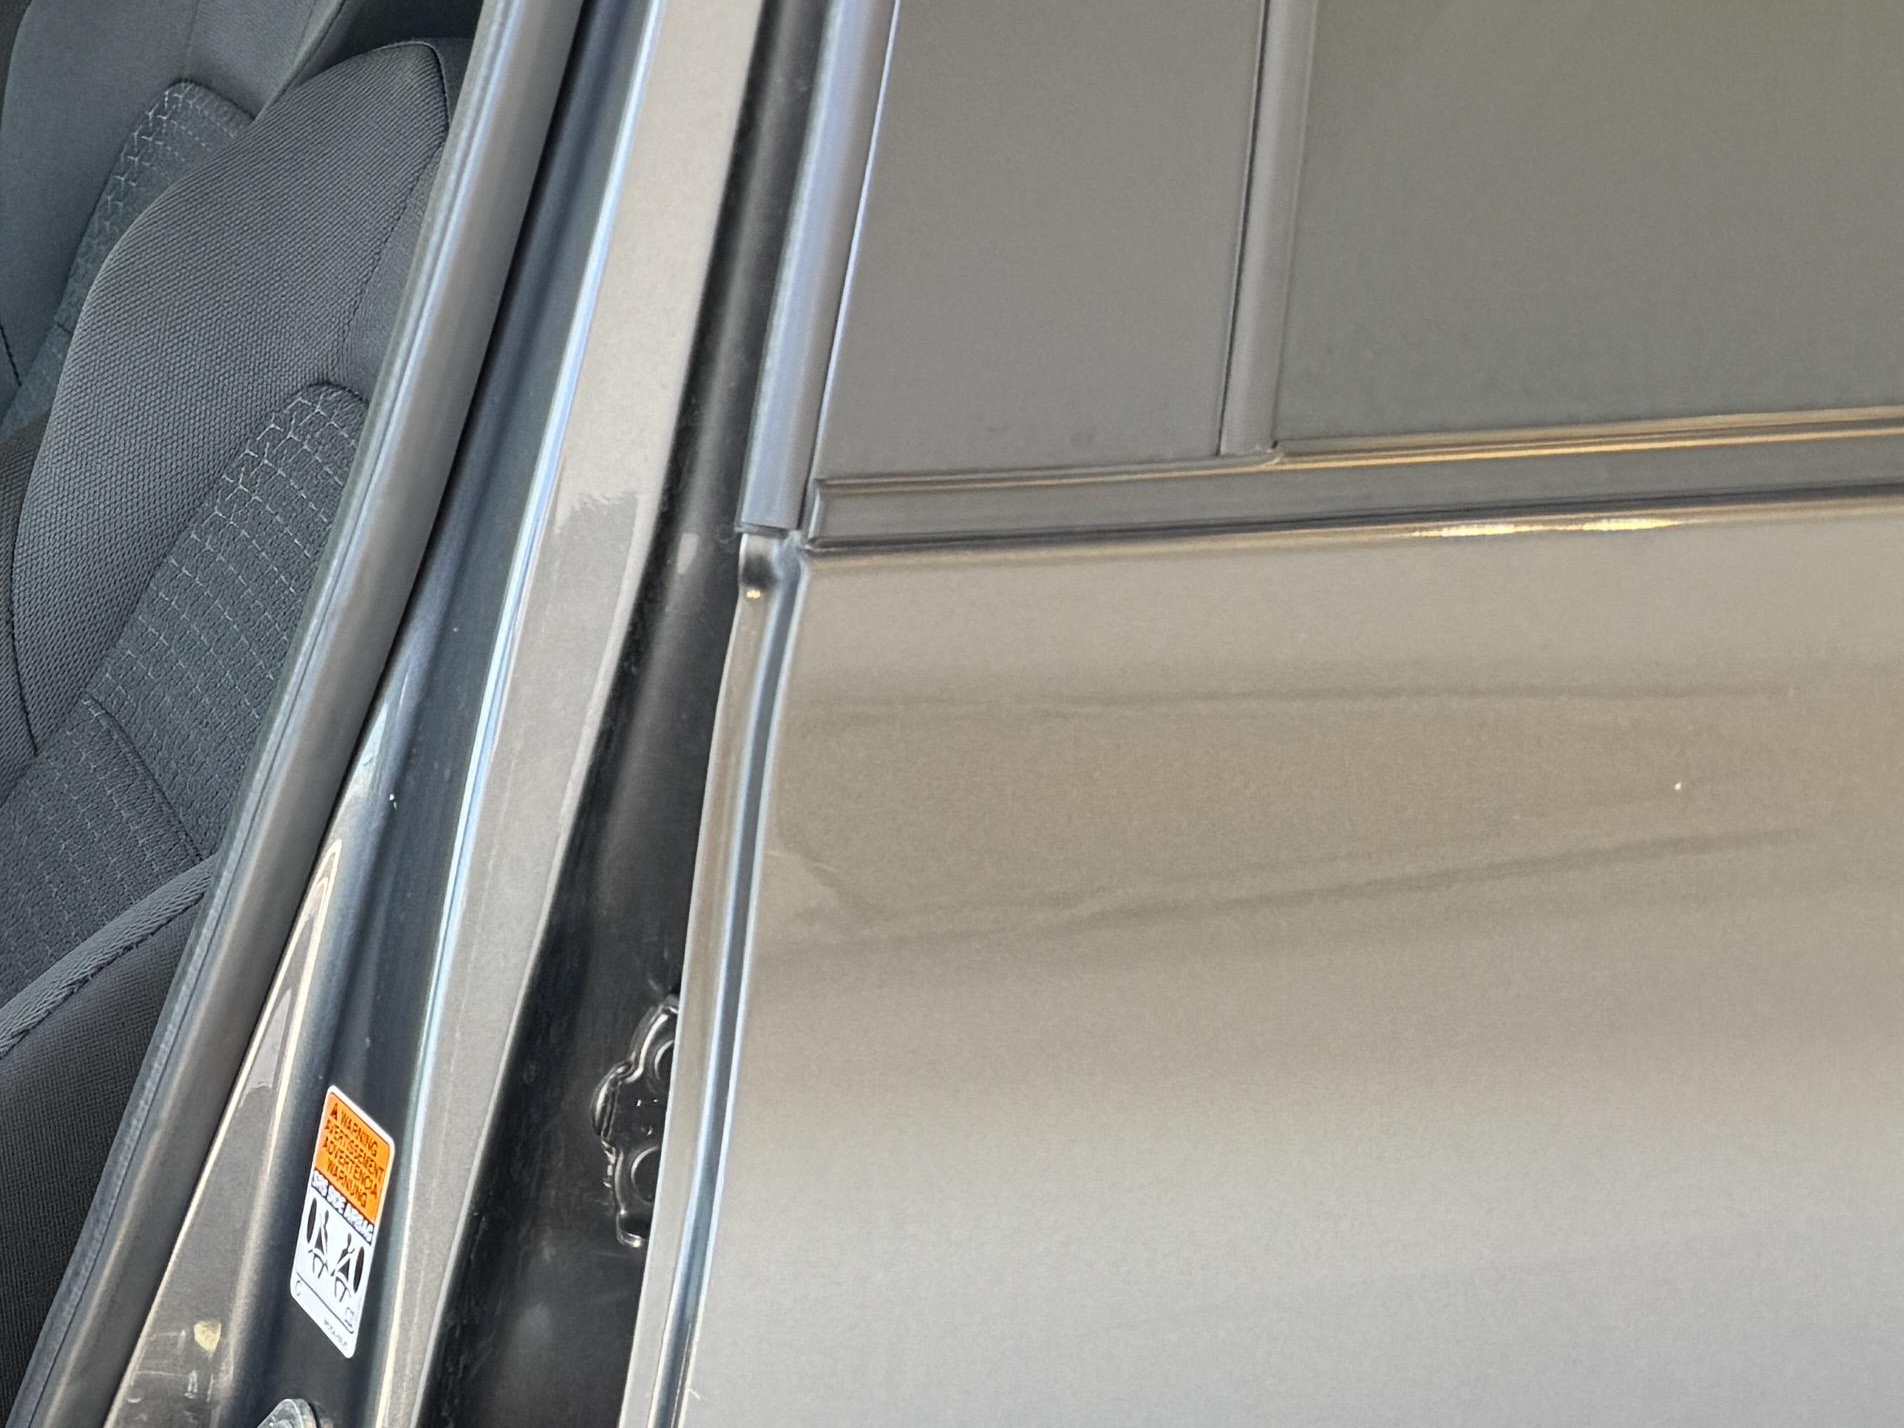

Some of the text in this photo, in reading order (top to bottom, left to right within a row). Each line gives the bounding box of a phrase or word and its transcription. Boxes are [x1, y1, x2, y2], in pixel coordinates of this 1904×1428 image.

[324, 1118, 385, 1180] AVERTISSEMENT
[340, 1110, 378, 1158] WARNING
[323, 1135, 378, 1200] ADVERTENCIA
[327, 1157, 368, 1209] WARNUNG
